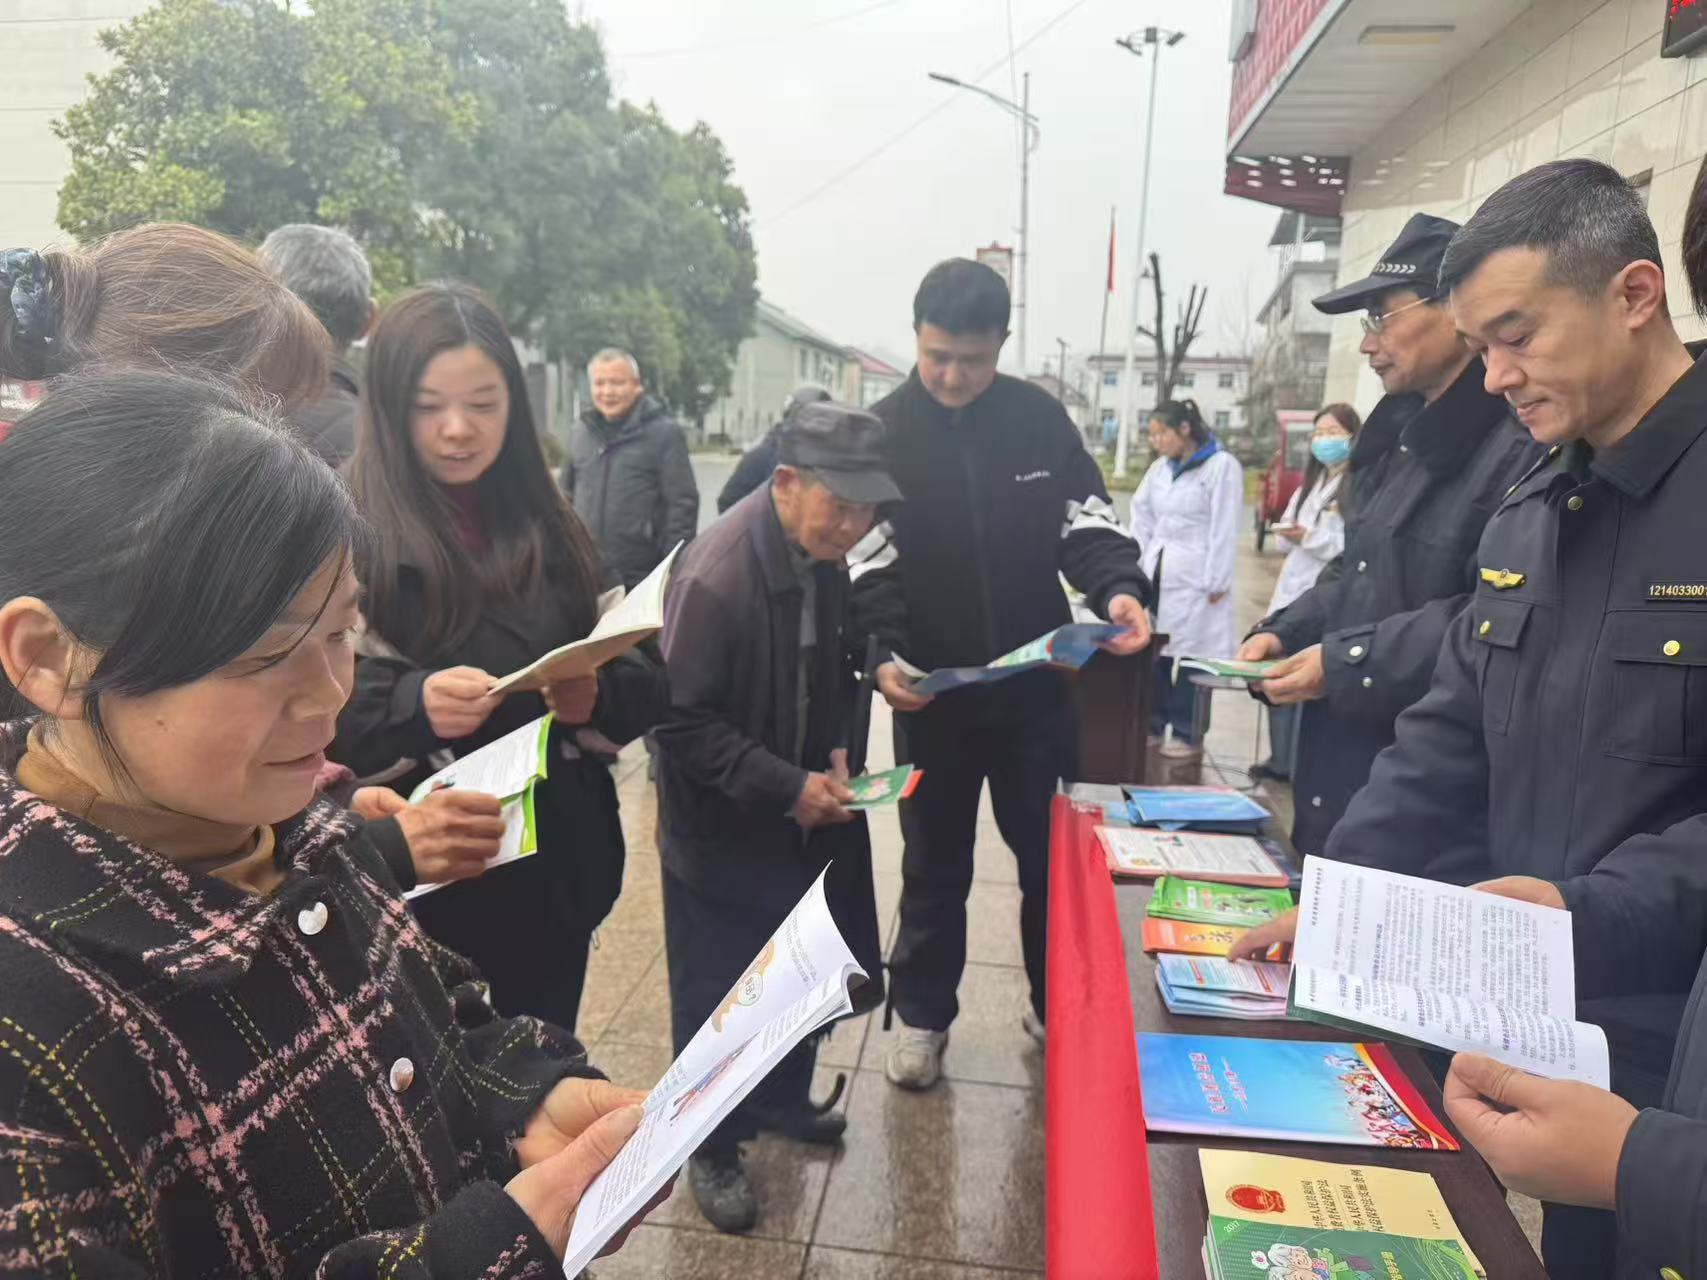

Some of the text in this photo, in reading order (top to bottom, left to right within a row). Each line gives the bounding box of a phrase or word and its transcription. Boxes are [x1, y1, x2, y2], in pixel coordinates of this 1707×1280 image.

[1316, 1179, 1343, 1230] 费者权益保护法
[1223, 1220, 1240, 1233] 2017
